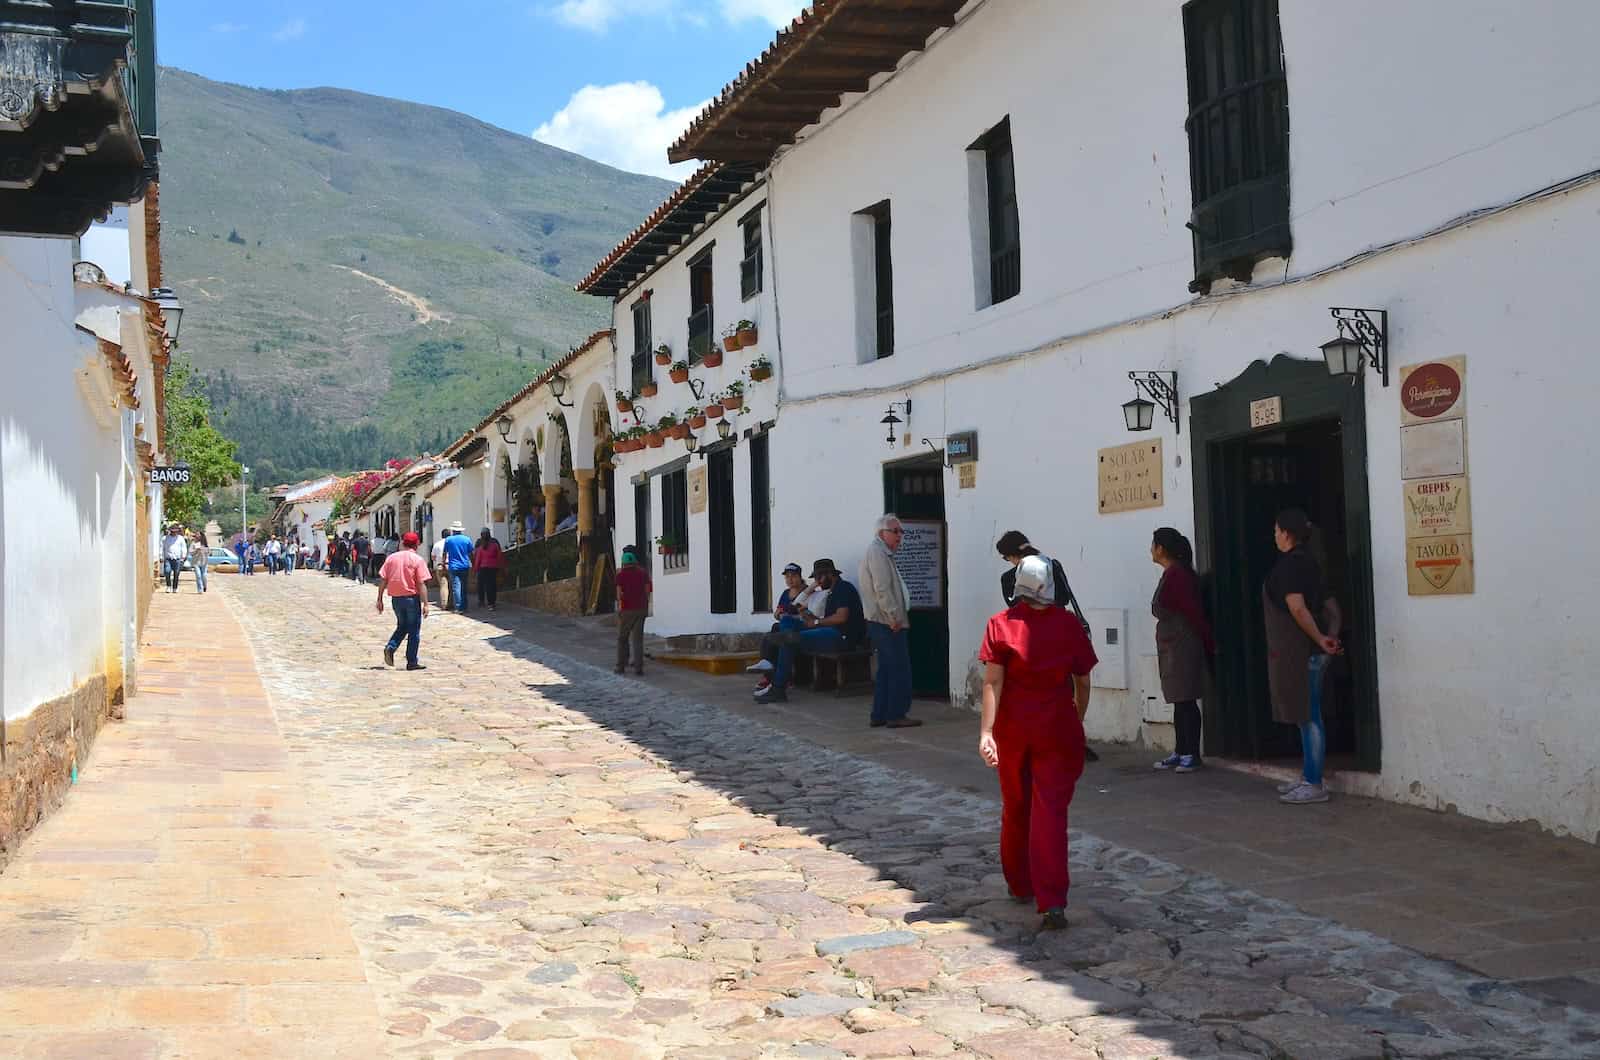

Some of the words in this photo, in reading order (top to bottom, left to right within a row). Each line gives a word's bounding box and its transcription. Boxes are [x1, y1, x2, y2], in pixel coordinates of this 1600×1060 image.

[151, 467, 189, 482] BAÑOS
[1417, 481, 1450, 495] CREPES
[1415, 543, 1459, 558] TAVOLO
